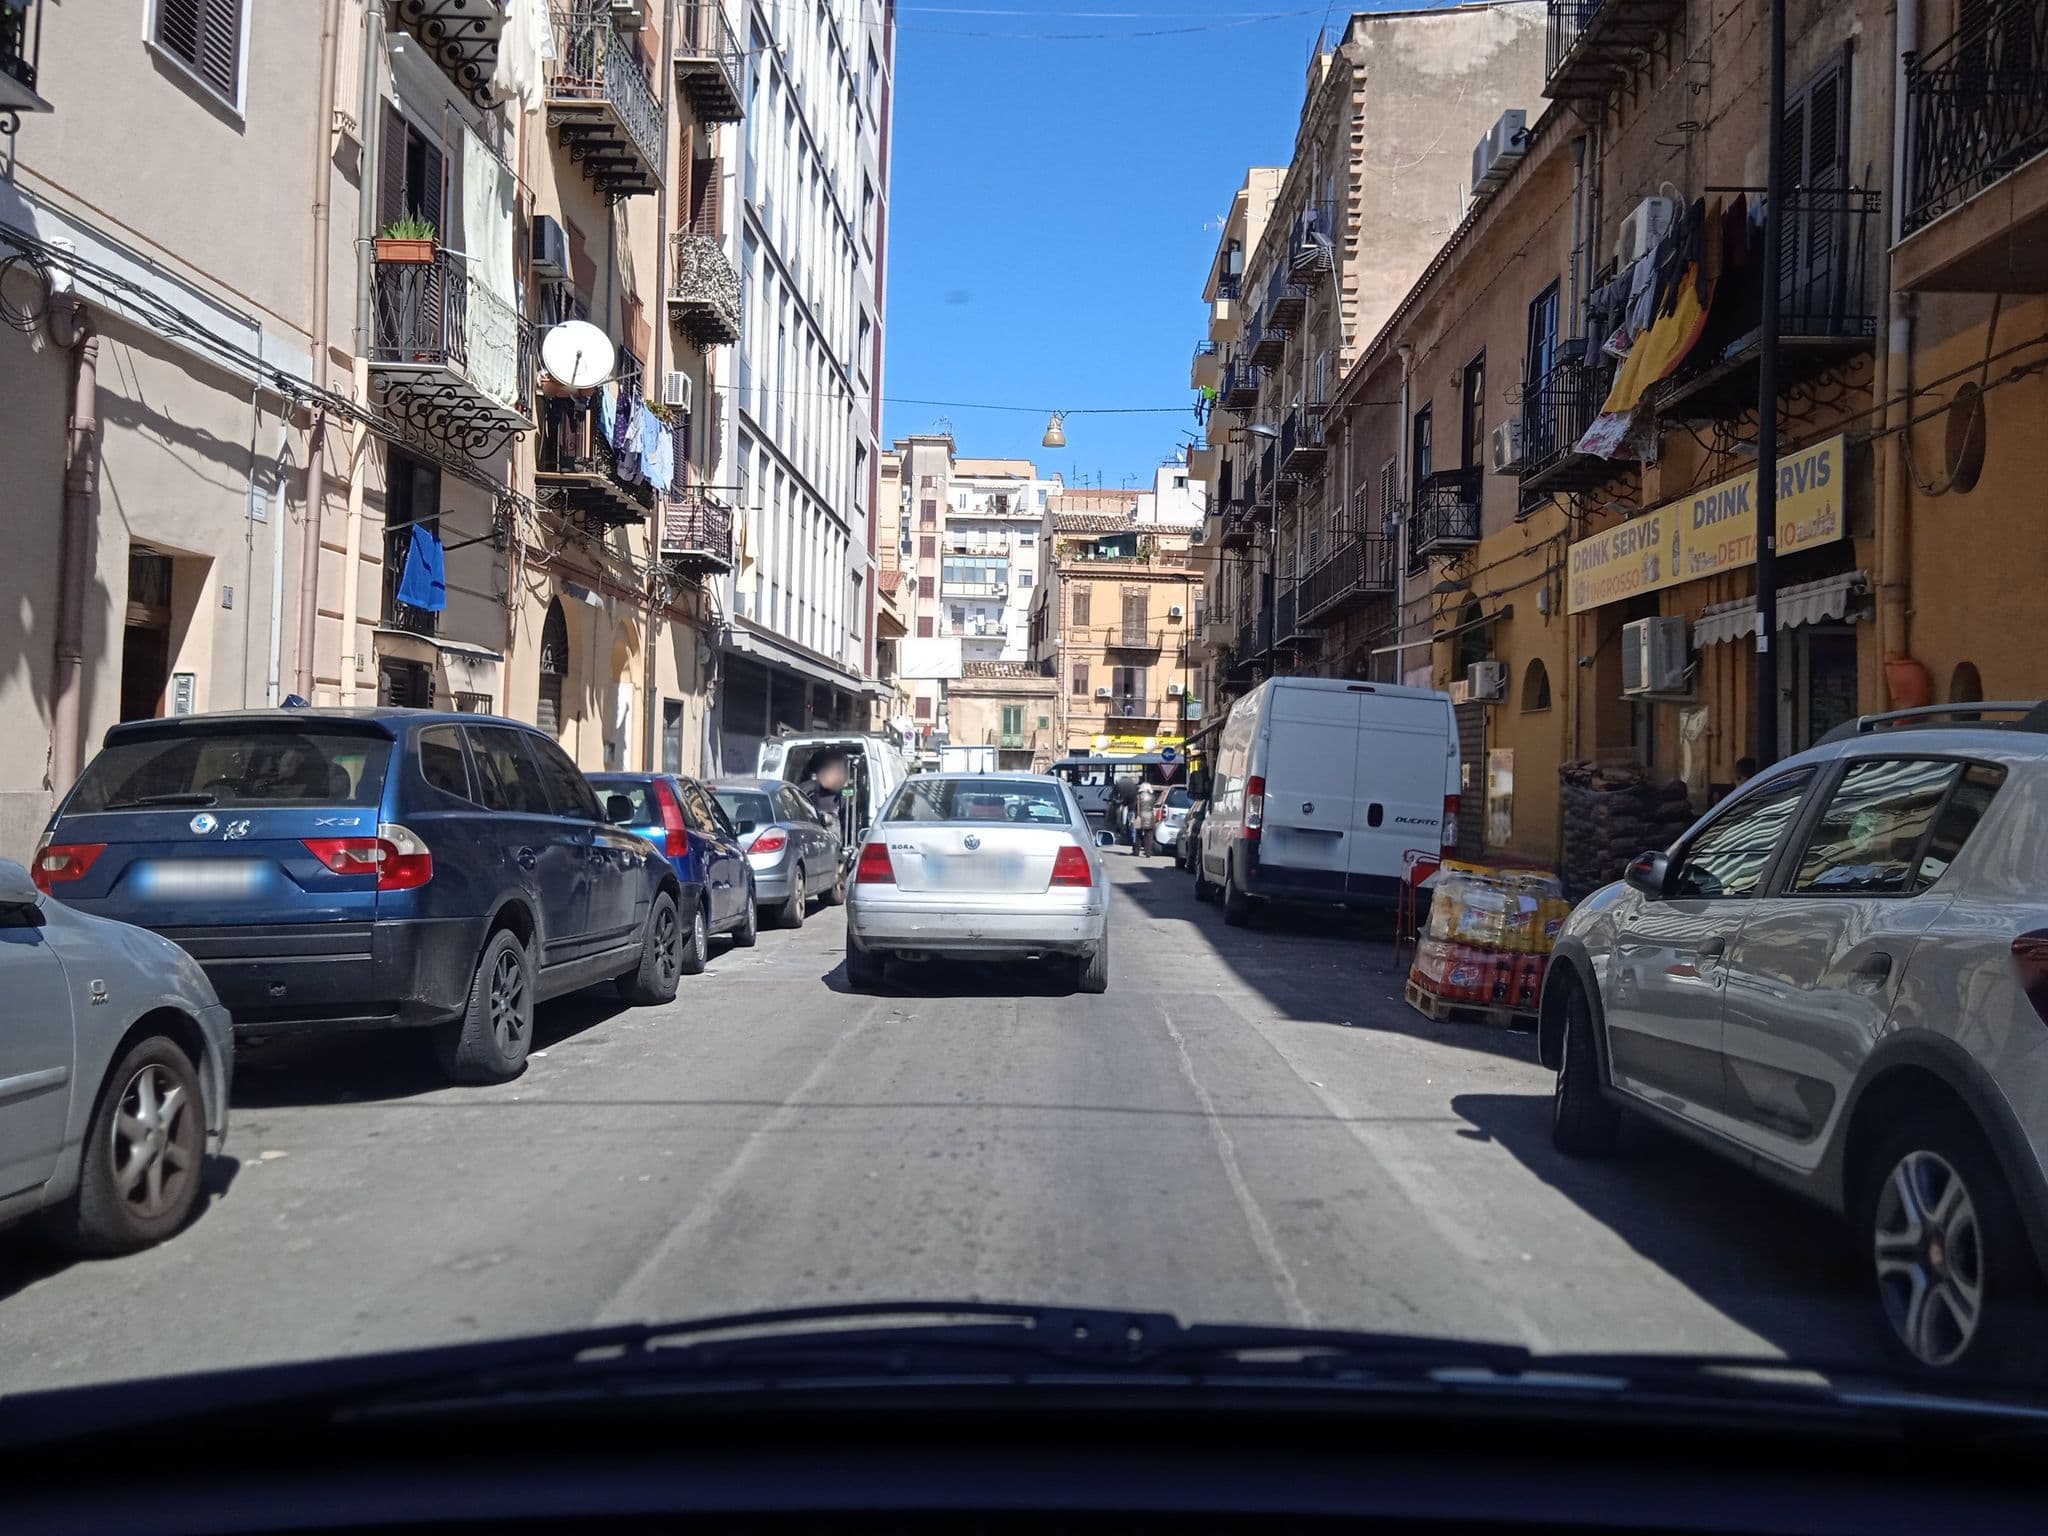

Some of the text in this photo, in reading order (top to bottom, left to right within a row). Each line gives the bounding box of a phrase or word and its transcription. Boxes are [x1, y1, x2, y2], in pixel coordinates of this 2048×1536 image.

[1693, 450, 1831, 530] DRINK RVIS
[1573, 517, 1660, 574] DRINK SERVIS
[1718, 521, 1796, 565] DETTAIO
[1590, 567, 1640, 602] INGROSSO
[315, 817, 360, 826] X3
[1394, 816, 1440, 826] DUCATO
